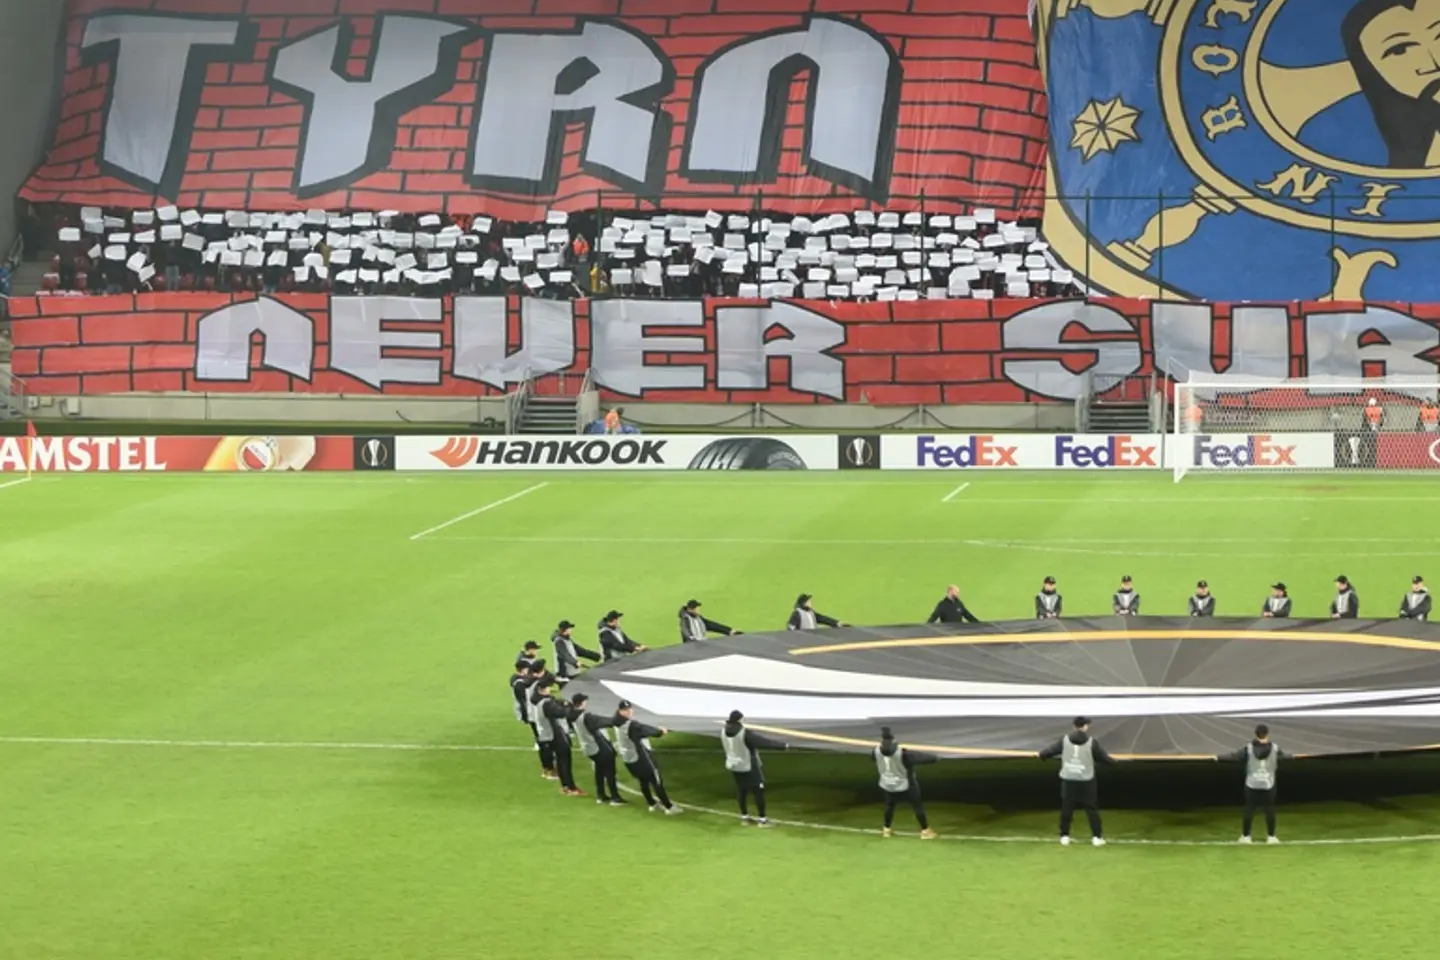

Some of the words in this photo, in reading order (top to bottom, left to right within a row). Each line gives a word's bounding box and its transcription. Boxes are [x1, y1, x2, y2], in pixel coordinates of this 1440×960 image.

[194, 295, 848, 400] NEVER
[0, 437, 167, 471] AMSTEL
[917, 436, 1018, 467] FedEx
[1055, 436, 1157, 467] FedEx
[1193, 435, 1298, 467] FedEx
